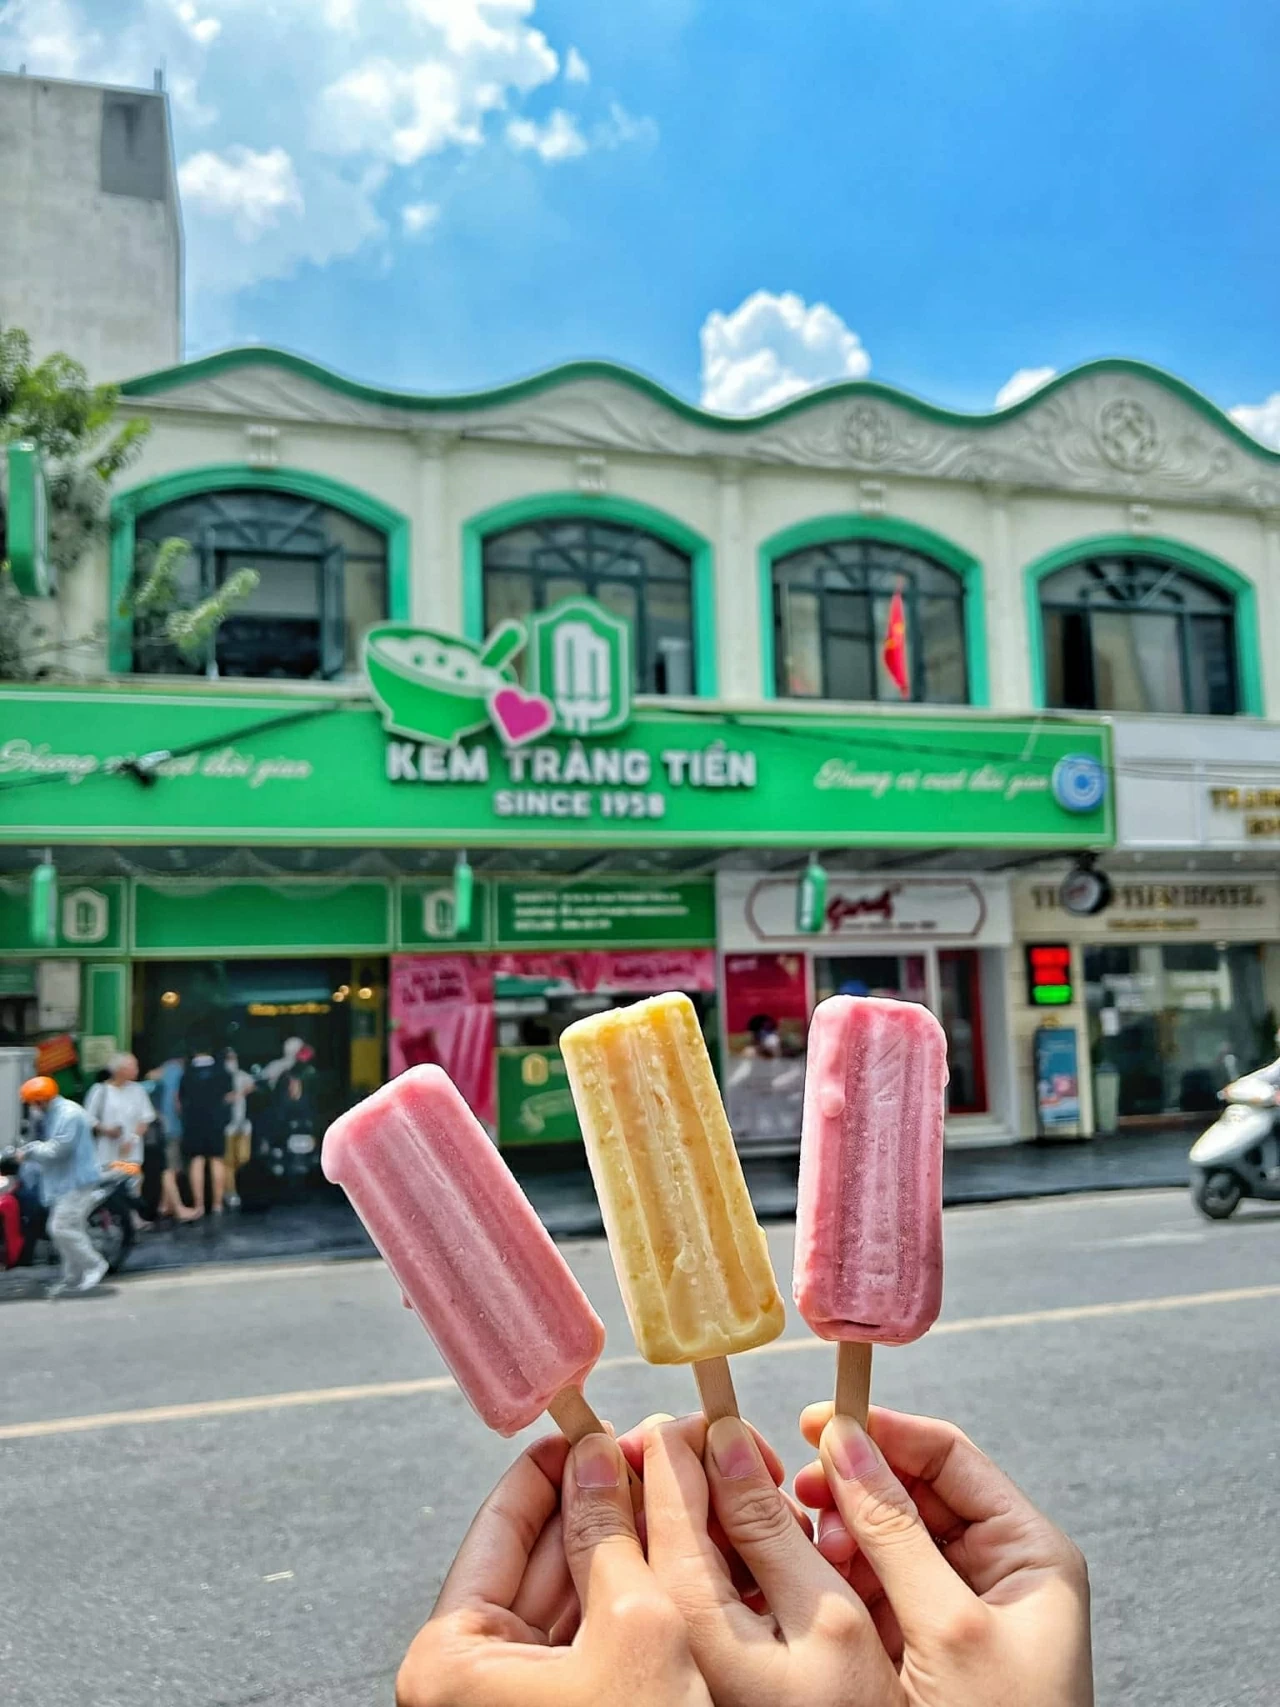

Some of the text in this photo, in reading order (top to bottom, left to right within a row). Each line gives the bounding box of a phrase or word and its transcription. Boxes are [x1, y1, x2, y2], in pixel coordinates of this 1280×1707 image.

[386, 740, 489, 783] KEM
[494, 790, 666, 819] SINCE 1958
